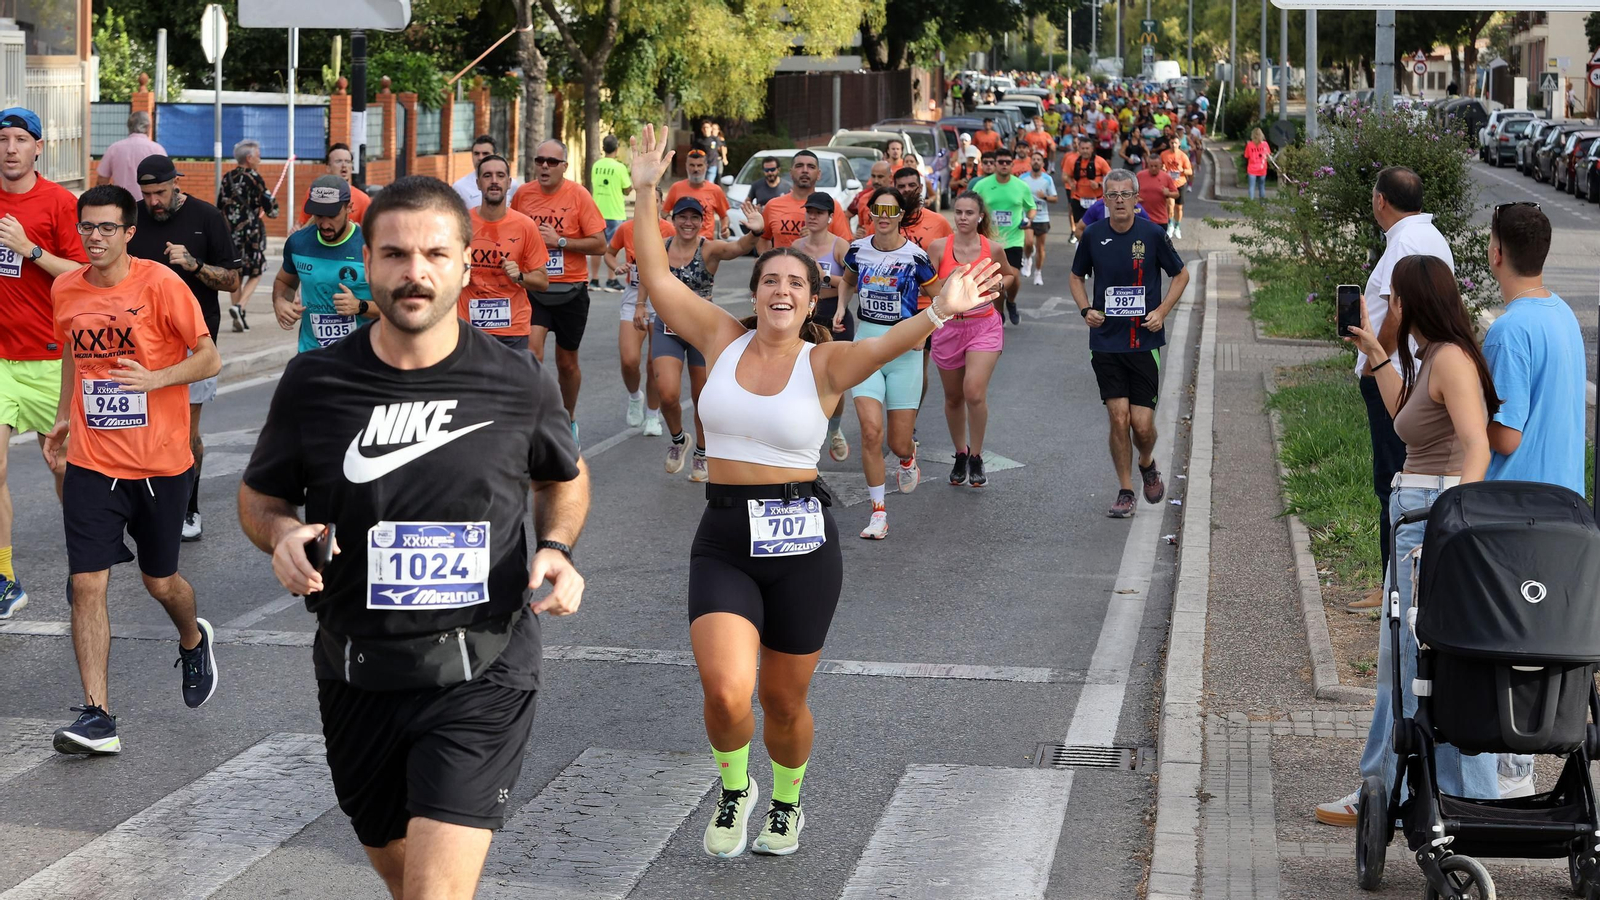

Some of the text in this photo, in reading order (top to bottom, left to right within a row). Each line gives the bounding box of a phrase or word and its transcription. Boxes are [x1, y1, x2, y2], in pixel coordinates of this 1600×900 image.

[1593, 73, 1600, 81] 3
[866, 299, 894, 311] 1085
[1114, 297, 1136, 307] 987
[479, 309, 499, 318] 771
[318, 325, 350, 337] 1035
[96, 396, 130, 413] 948
[361, 400, 458, 447] NIKE
[768, 516, 807, 538] 707
[389, 552, 469, 581] 1024
